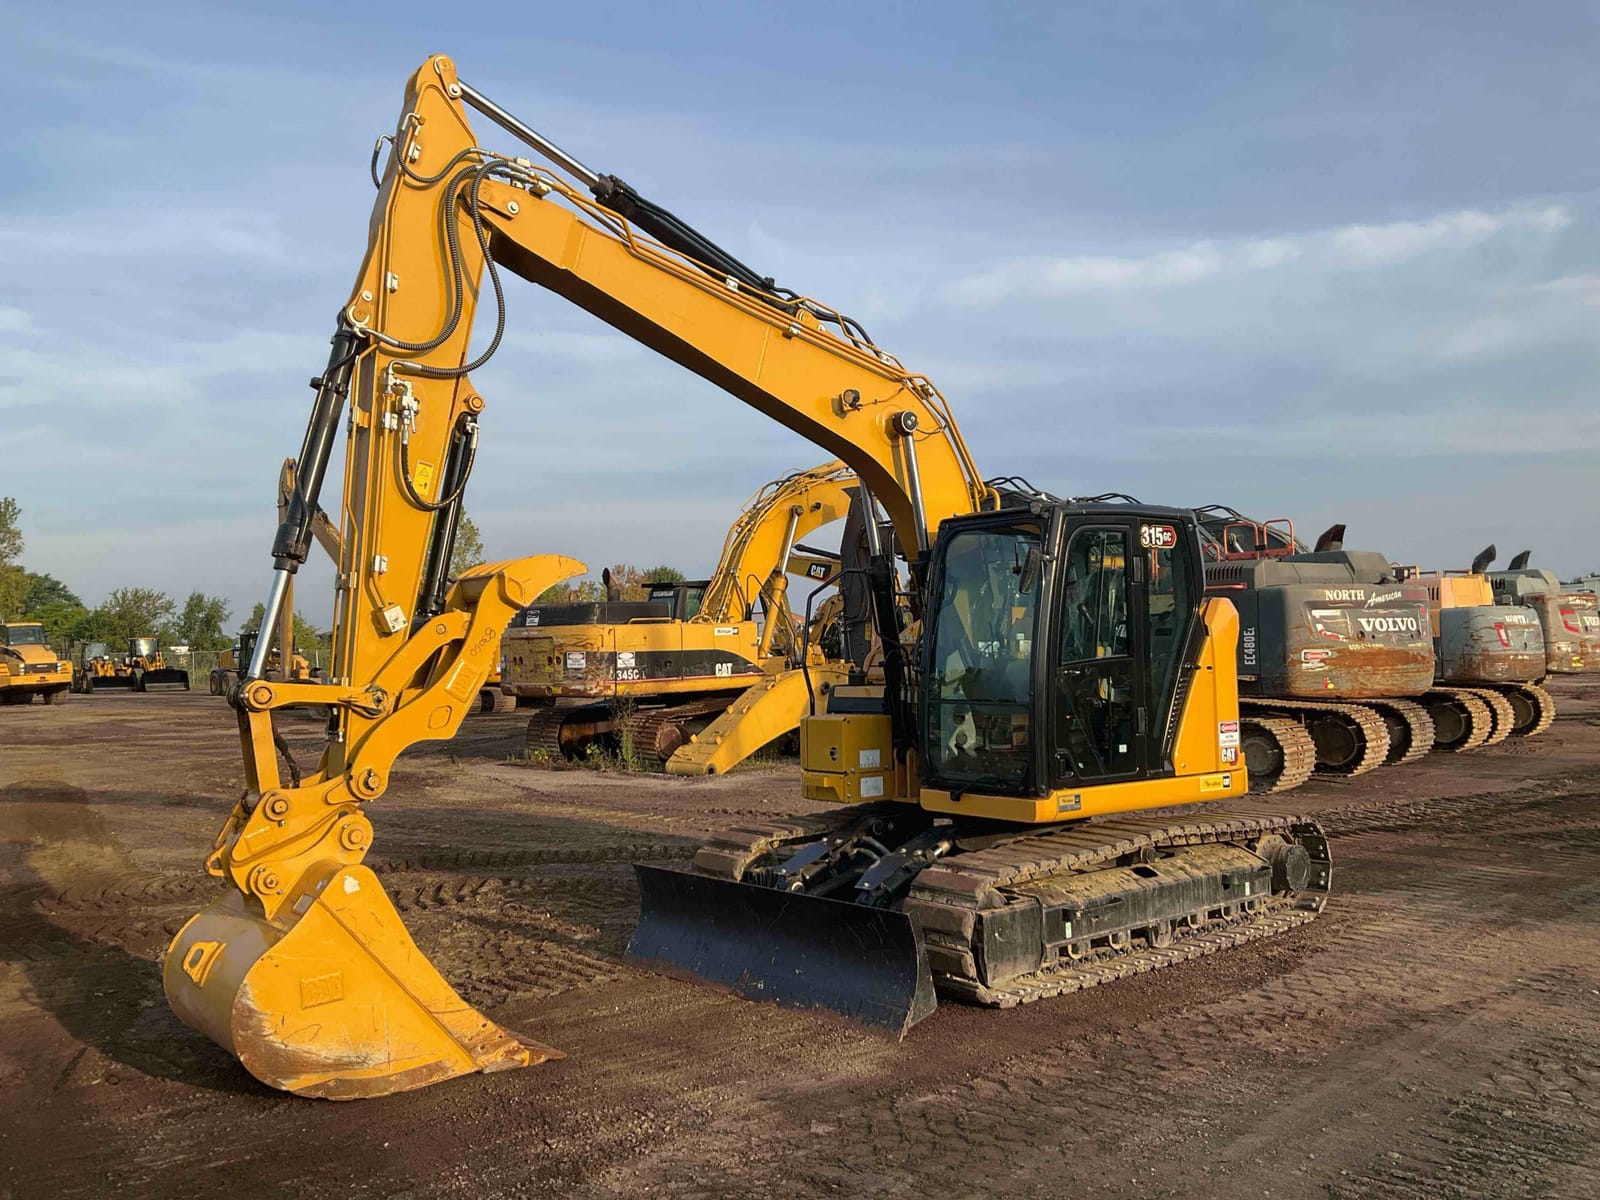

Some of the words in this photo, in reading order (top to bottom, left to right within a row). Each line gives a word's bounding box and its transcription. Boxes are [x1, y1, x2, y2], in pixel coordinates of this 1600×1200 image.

[1141, 526, 1163, 546] 315
[1163, 531, 1172, 542] GC
[810, 565, 826, 578] CAT
[1325, 589, 1365, 601] NORTH
[1364, 590, 1402, 609] American
[1358, 617, 1418, 632] VOLVO
[616, 669, 640, 680] 345C
[715, 662, 733, 677] CAT
[1221, 747, 1237, 763] CAT
